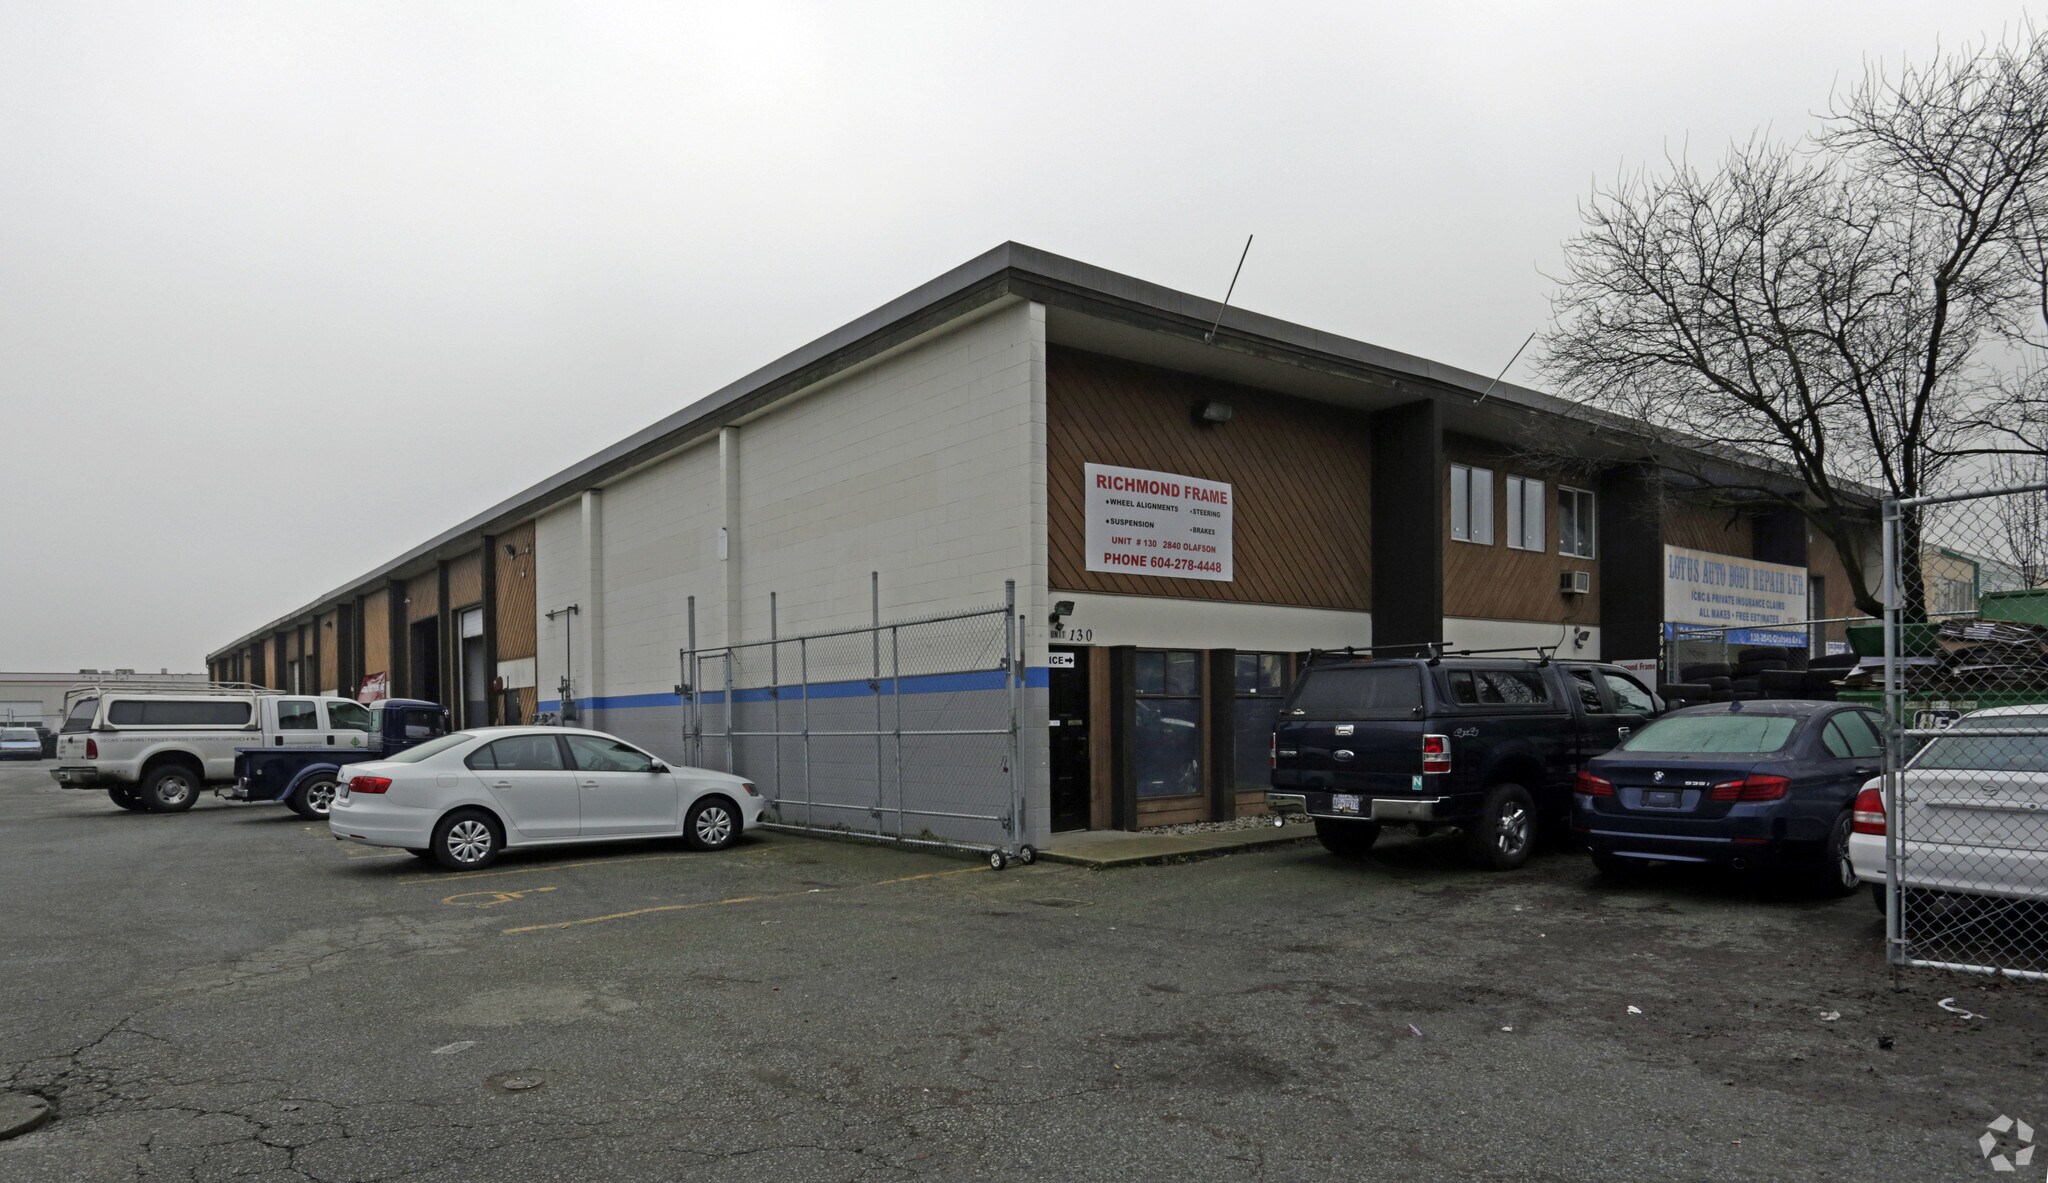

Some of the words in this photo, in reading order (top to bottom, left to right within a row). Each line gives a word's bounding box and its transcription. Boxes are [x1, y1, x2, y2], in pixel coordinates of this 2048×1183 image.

[1096, 474, 1180, 497] RICHMOND
[1184, 485, 1228, 505] FRAME
[1110, 498, 1135, 508] WHEEL
[1136, 501, 1179, 512] ALIGNMENTS
[1192, 508, 1221, 518] STEERING
[1110, 517, 1155, 528] SUSPENSION
[1192, 526, 1216, 536] BRAKES
[1111, 536, 1132, 545] UNIT
[1162, 540, 1181, 550] 2840
[1183, 542, 1216, 554] OLAFSON
[1104, 552, 1147, 567] PHONE
[1150, 556, 1222, 573] 604-278-4448
[1668, 554, 1699, 583] LOTUS
[1702, 560, 1726, 586] AUTO
[1728, 564, 1751, 589] BODY
[1753, 568, 1785, 594] REPAIR
[1787, 573, 1805, 596] LTD.
[1691, 590, 1705, 602] ICBC
[1711, 593, 1735, 605] PRIVATE
[1735, 595, 1765, 609] INSURANCE
[1766, 600, 1785, 611] CLAIMS
[1698, 607, 1710, 618] ALL
[1711, 608, 1731, 620] MAKES
[1735, 611, 1750, 622] FREE
[1750, 612, 1779, 624] ESTIMATES
[1069, 628, 1093, 642] 130
[1049, 656, 1064, 665] ICE
[1640, 662, 1656, 670] Frame
